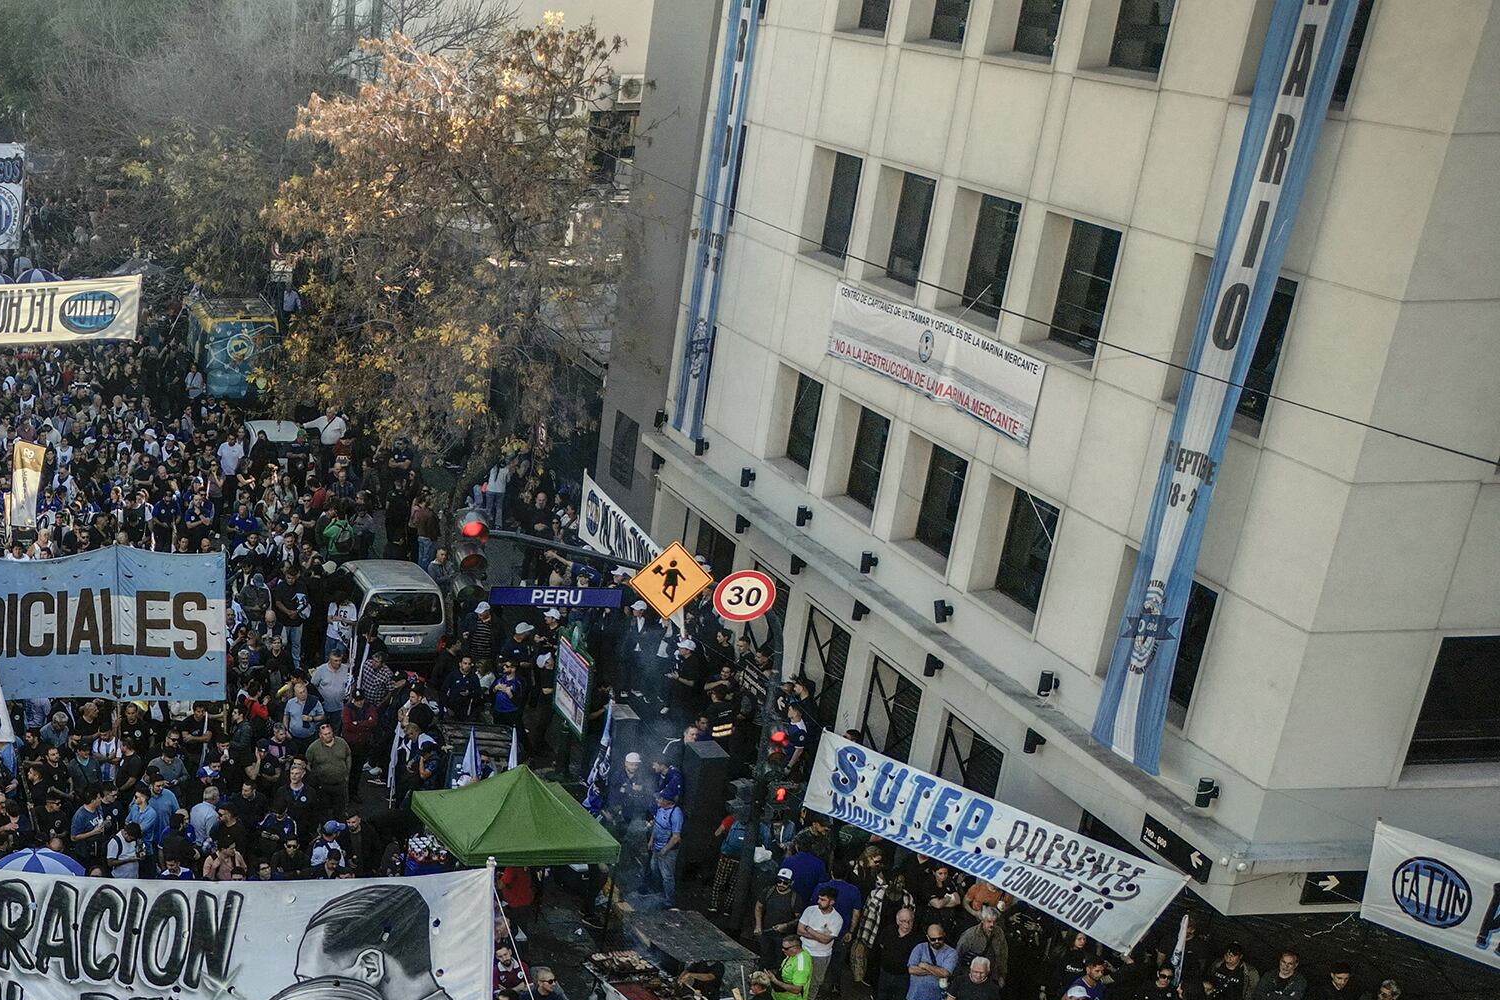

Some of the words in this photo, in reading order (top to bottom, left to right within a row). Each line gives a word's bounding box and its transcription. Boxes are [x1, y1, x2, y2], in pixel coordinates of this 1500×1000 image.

[840, 287, 860, 302] CENTRO
[867, 296, 894, 315] CAPITANES
[893, 305, 902, 317] DE
[901, 309, 930, 327] ULTRAMAR
[934, 320, 963, 341] OFICIALES
[963, 329, 972, 344] DE
[972, 334, 981, 346] LA
[981, 338, 1004, 358] MARINA
[845, 341, 853, 355] A
[852, 345, 863, 361] LA
[863, 349, 915, 382] DESTRUCCIÓN
[914, 371, 925, 387] DE
[926, 376, 936, 393] LA
[530, 588, 583, 605] PERU
[726, 585, 763, 607] 30
[828, 796, 889, 832] MIGUEL
[1003, 818, 1146, 894] PRESENTE
[1399, 863, 1466, 929] FATUN
